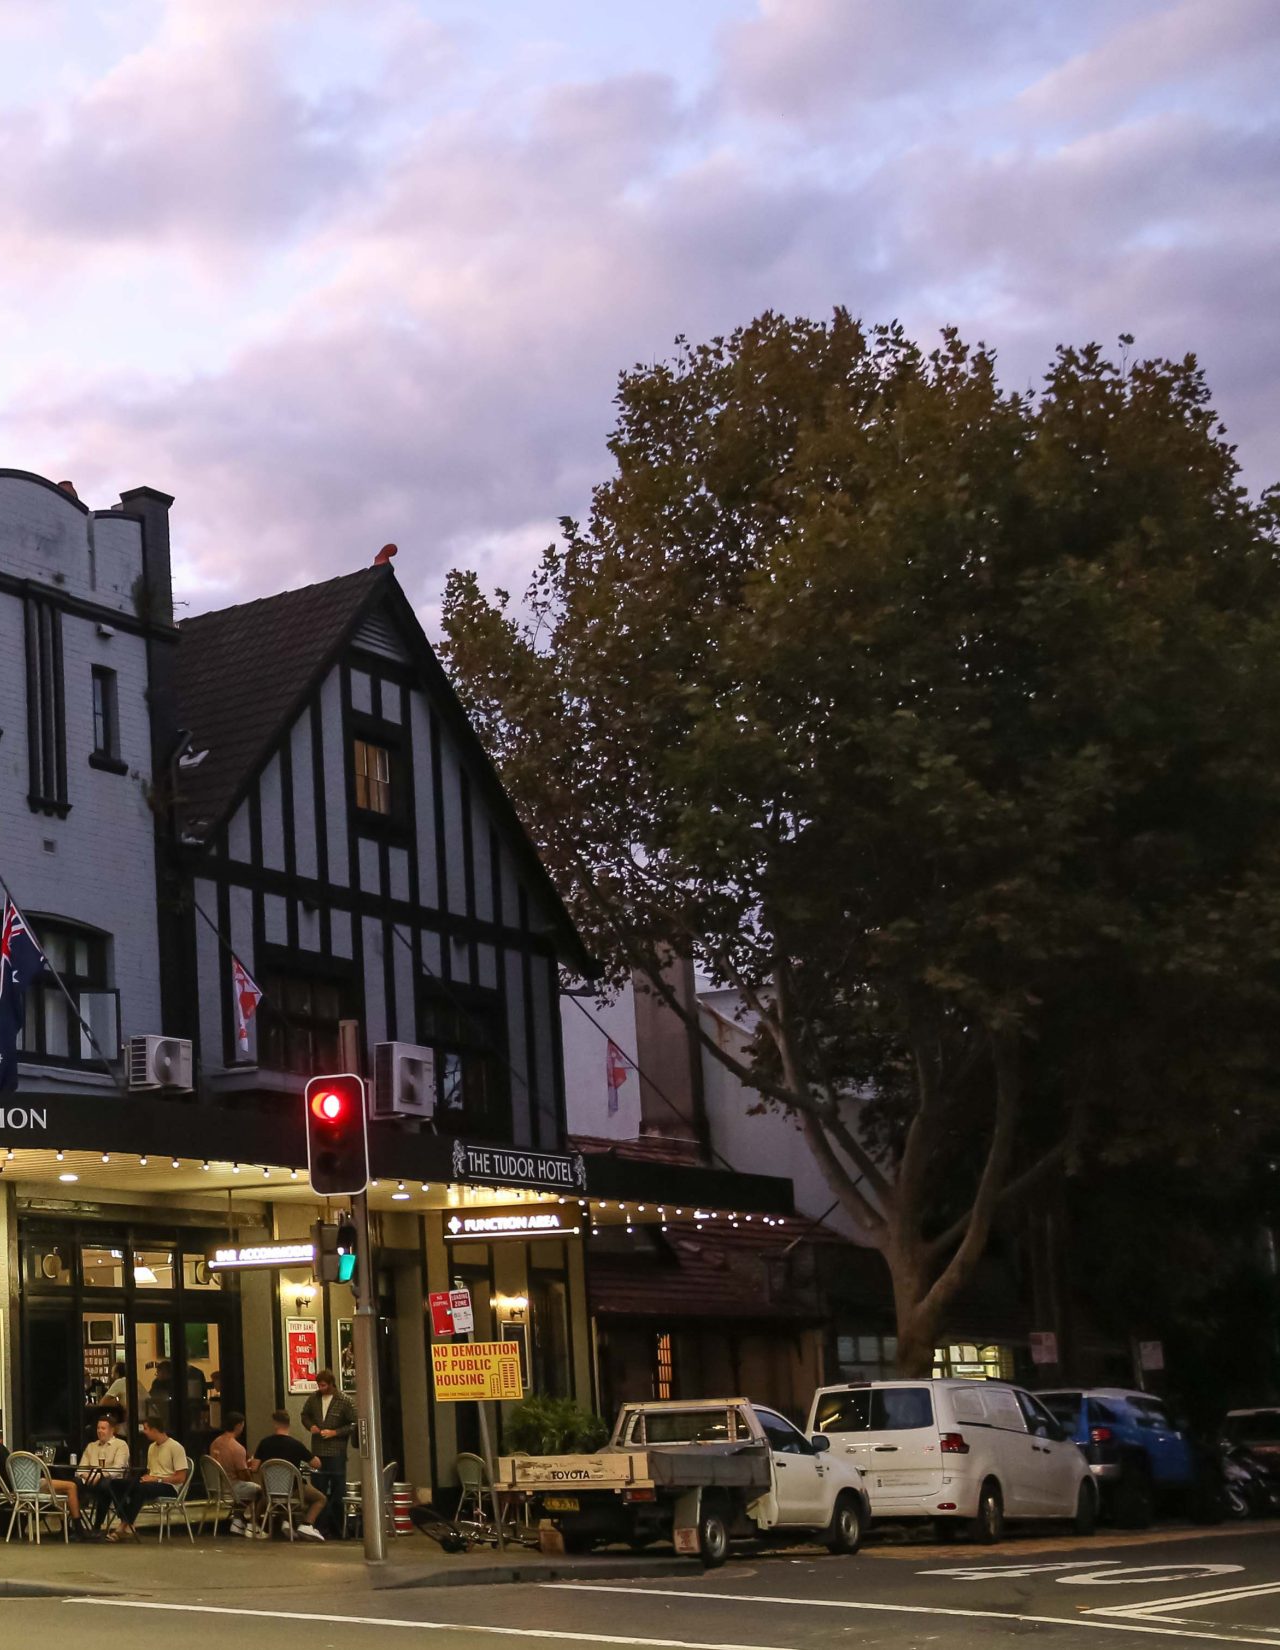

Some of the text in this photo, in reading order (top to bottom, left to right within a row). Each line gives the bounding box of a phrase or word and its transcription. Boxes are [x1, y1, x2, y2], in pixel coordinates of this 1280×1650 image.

[467, 1152, 573, 1182] THE TUDOR HOTEL
[464, 1214, 560, 1232] FUNCTION AREA
[433, 1343, 517, 1357] NO DEMOLITION
[435, 1359, 491, 1372] OF PUBLIC
[436, 1374, 484, 1386] HOUSING
[551, 1470, 590, 1480] TOYOTA
[914, 1560, 1245, 1584] 40
